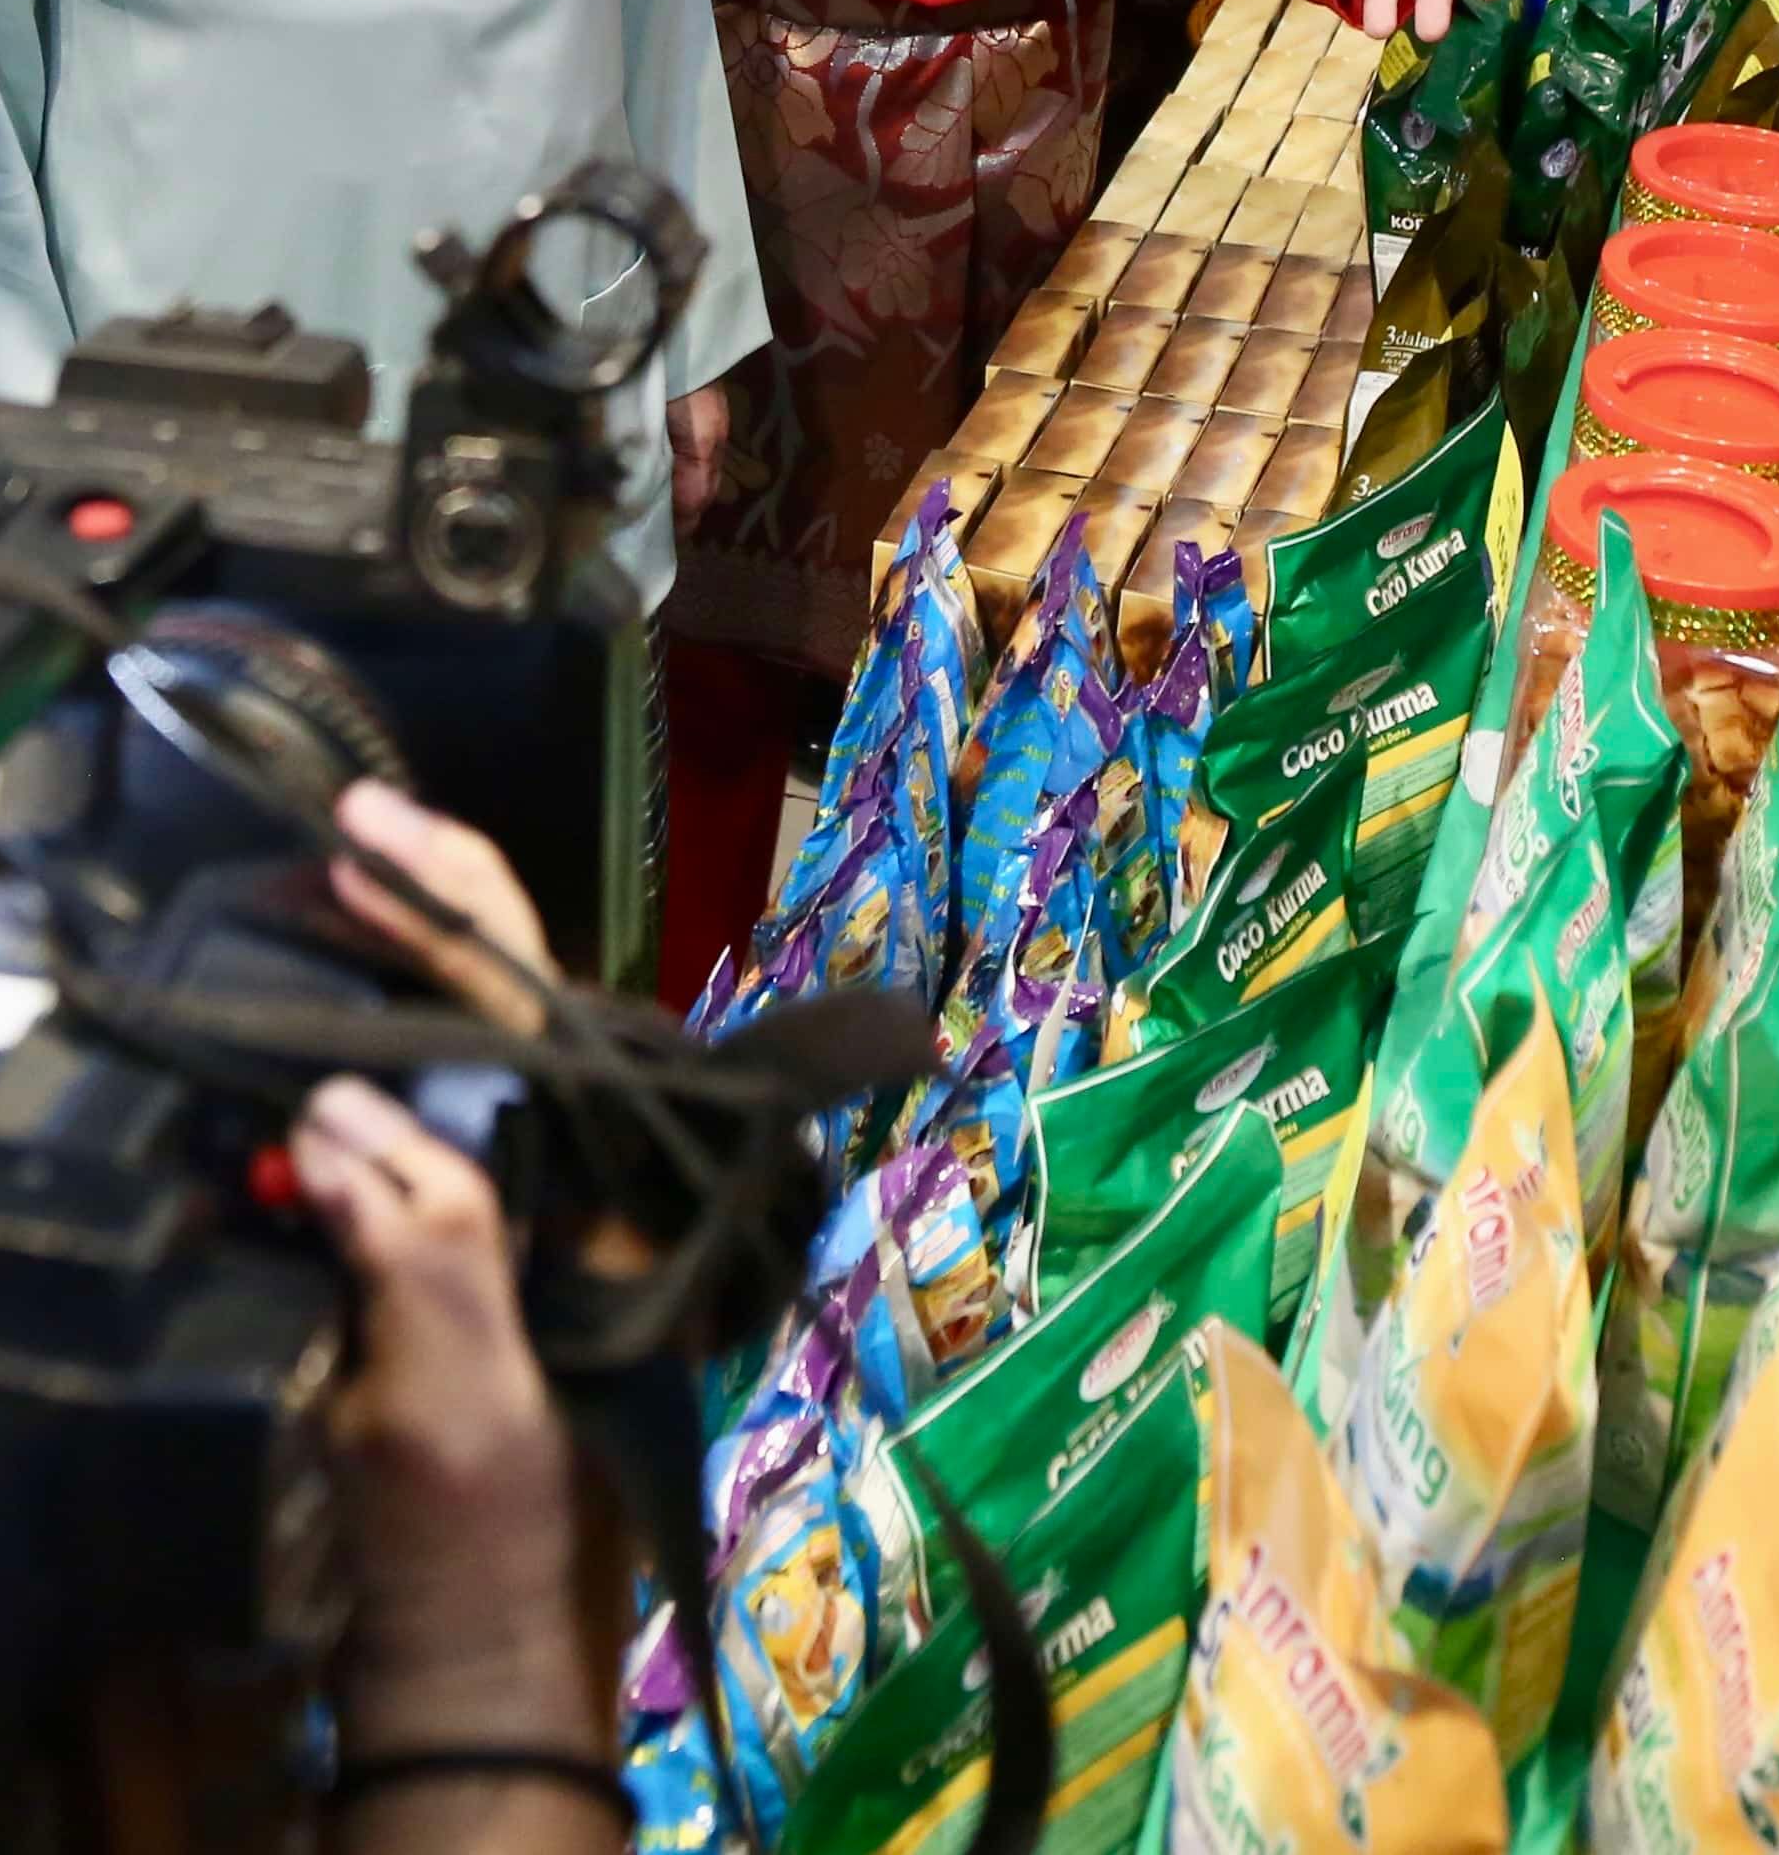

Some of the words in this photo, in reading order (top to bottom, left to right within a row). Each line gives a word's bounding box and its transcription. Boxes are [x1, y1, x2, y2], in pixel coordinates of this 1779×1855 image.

[1365, 572, 1408, 617] Coco
[1281, 727, 1345, 778] Coco
[1217, 920, 1265, 983] Coco
[1265, 860, 1328, 937] Kurma
[1257, 1065, 1331, 1123] rma
[1043, 1595, 1117, 1673] rma
